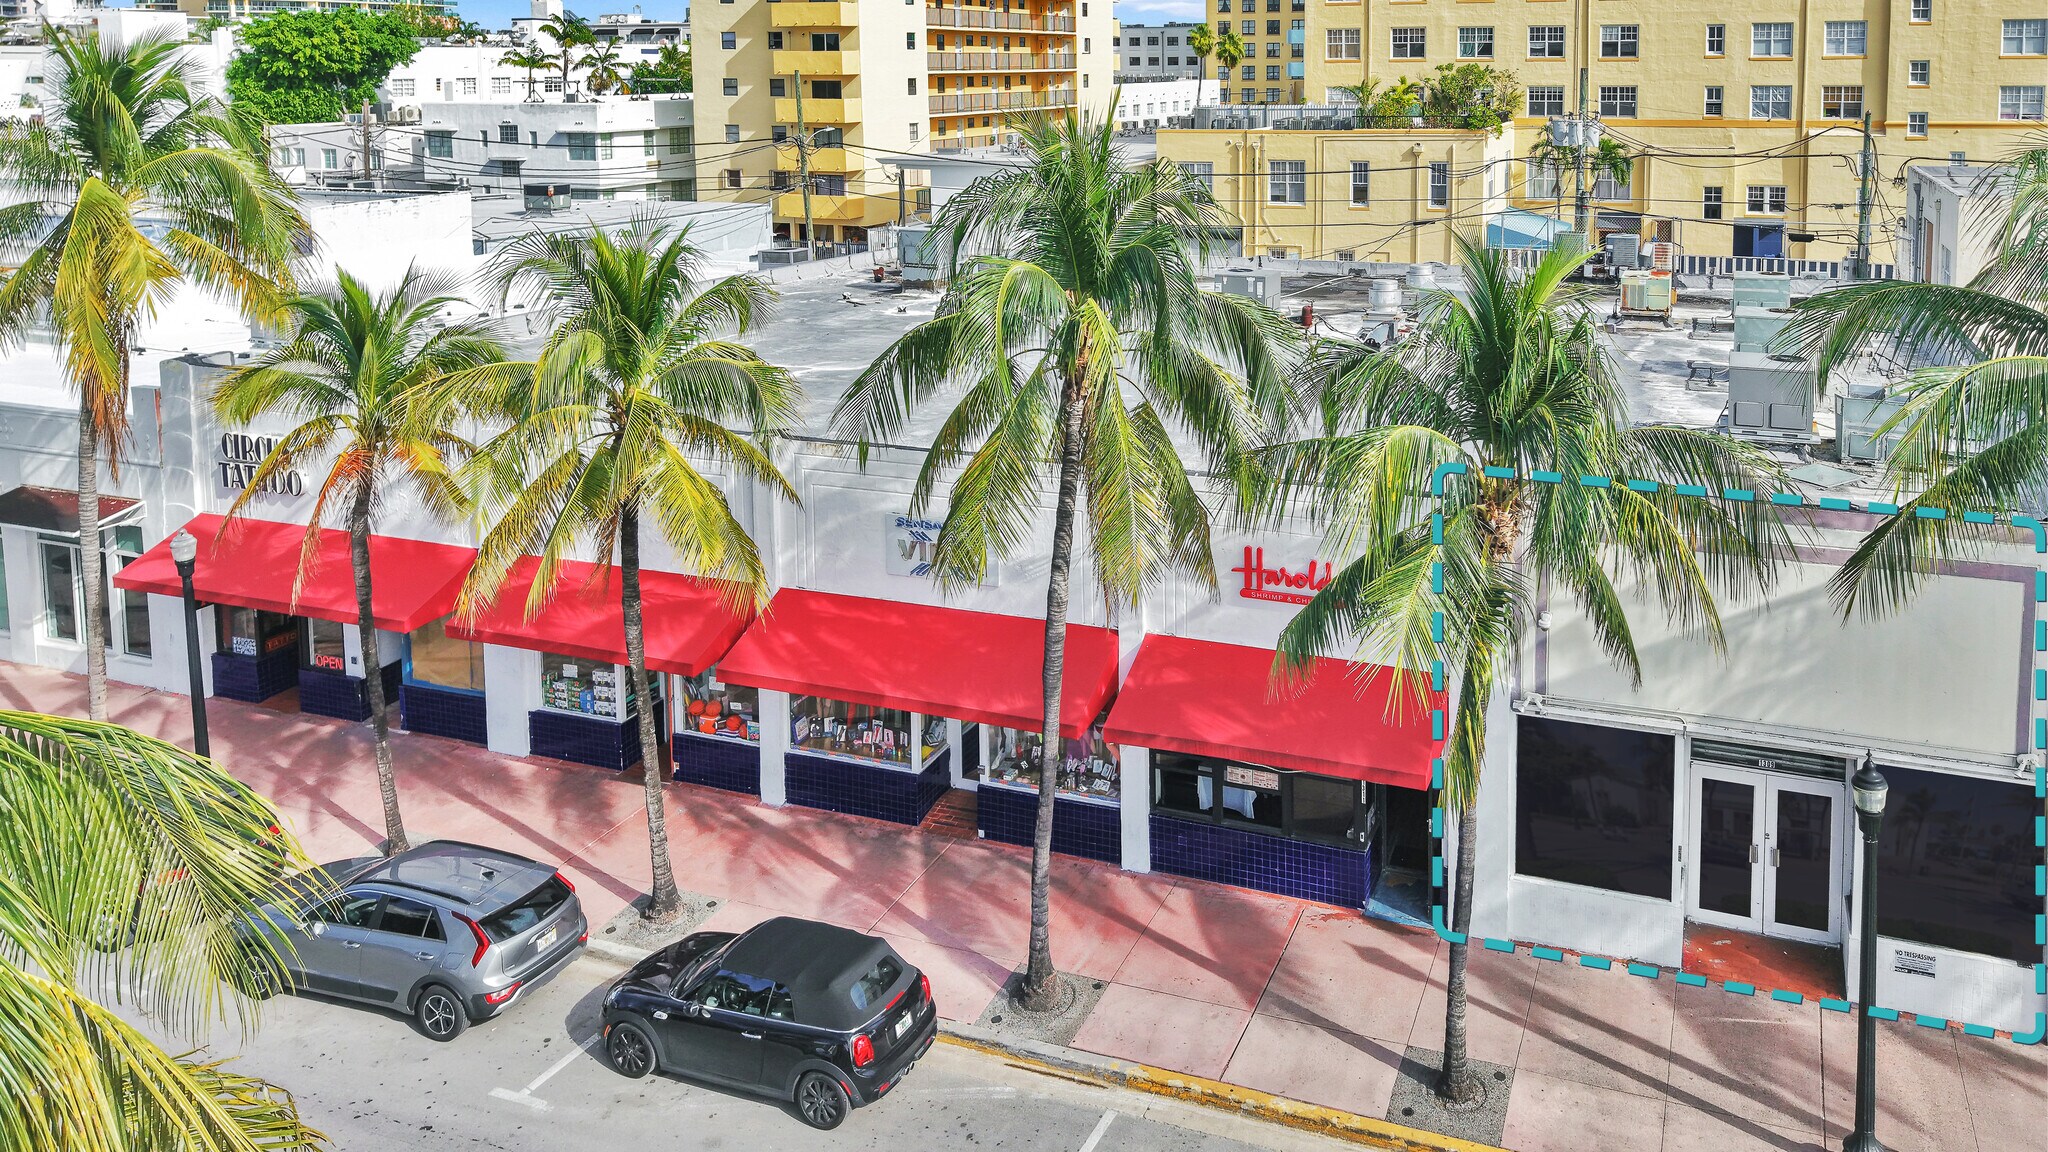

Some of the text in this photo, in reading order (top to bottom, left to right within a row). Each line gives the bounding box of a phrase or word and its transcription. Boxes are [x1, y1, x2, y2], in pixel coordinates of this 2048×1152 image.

[221, 432, 278, 463] CIRCU
[218, 461, 302, 497] TATOO
[1231, 545, 1331, 591] Harold
[1251, 591, 1283, 601] SHRIMP
[315, 654, 343, 670] OPEN
[1904, 951, 1936, 962] TRESPASSING
